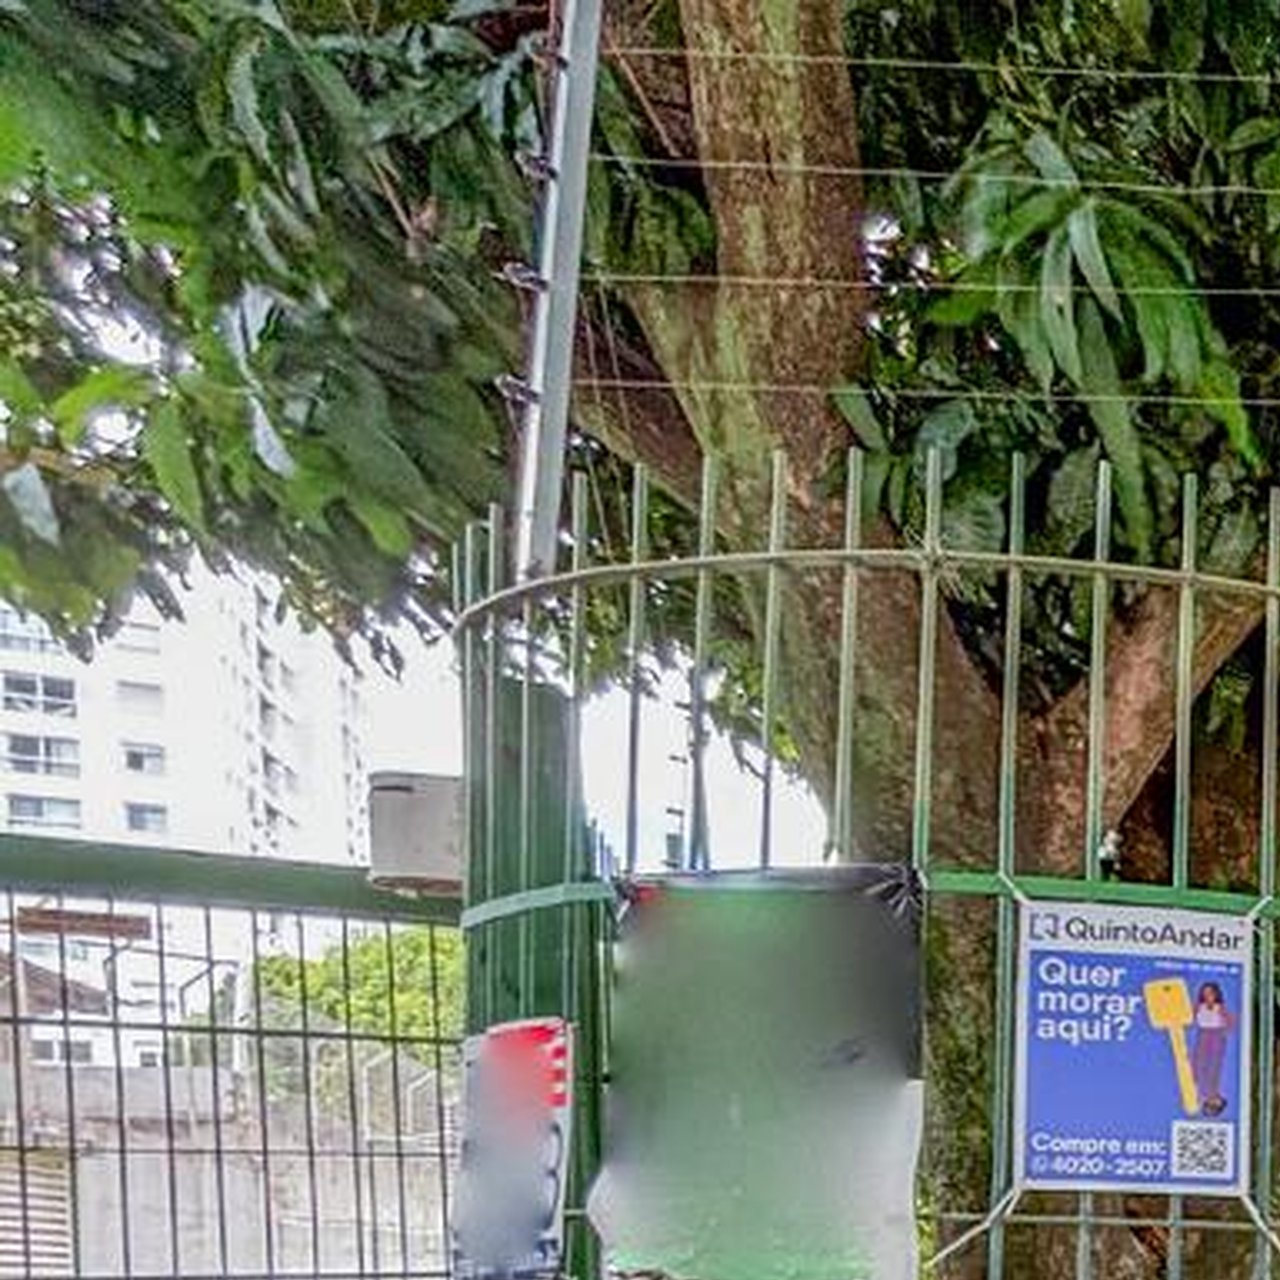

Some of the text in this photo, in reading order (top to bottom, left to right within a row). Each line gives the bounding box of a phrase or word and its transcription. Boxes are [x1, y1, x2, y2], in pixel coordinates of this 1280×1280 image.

[1065, 915, 1244, 950] QuintoAndar
[1038, 957, 1127, 986] Quer
[1037, 990, 1142, 1015] morar
[1036, 1016, 1132, 1045] aqui?
[1031, 1131, 1121, 1156] Compre
